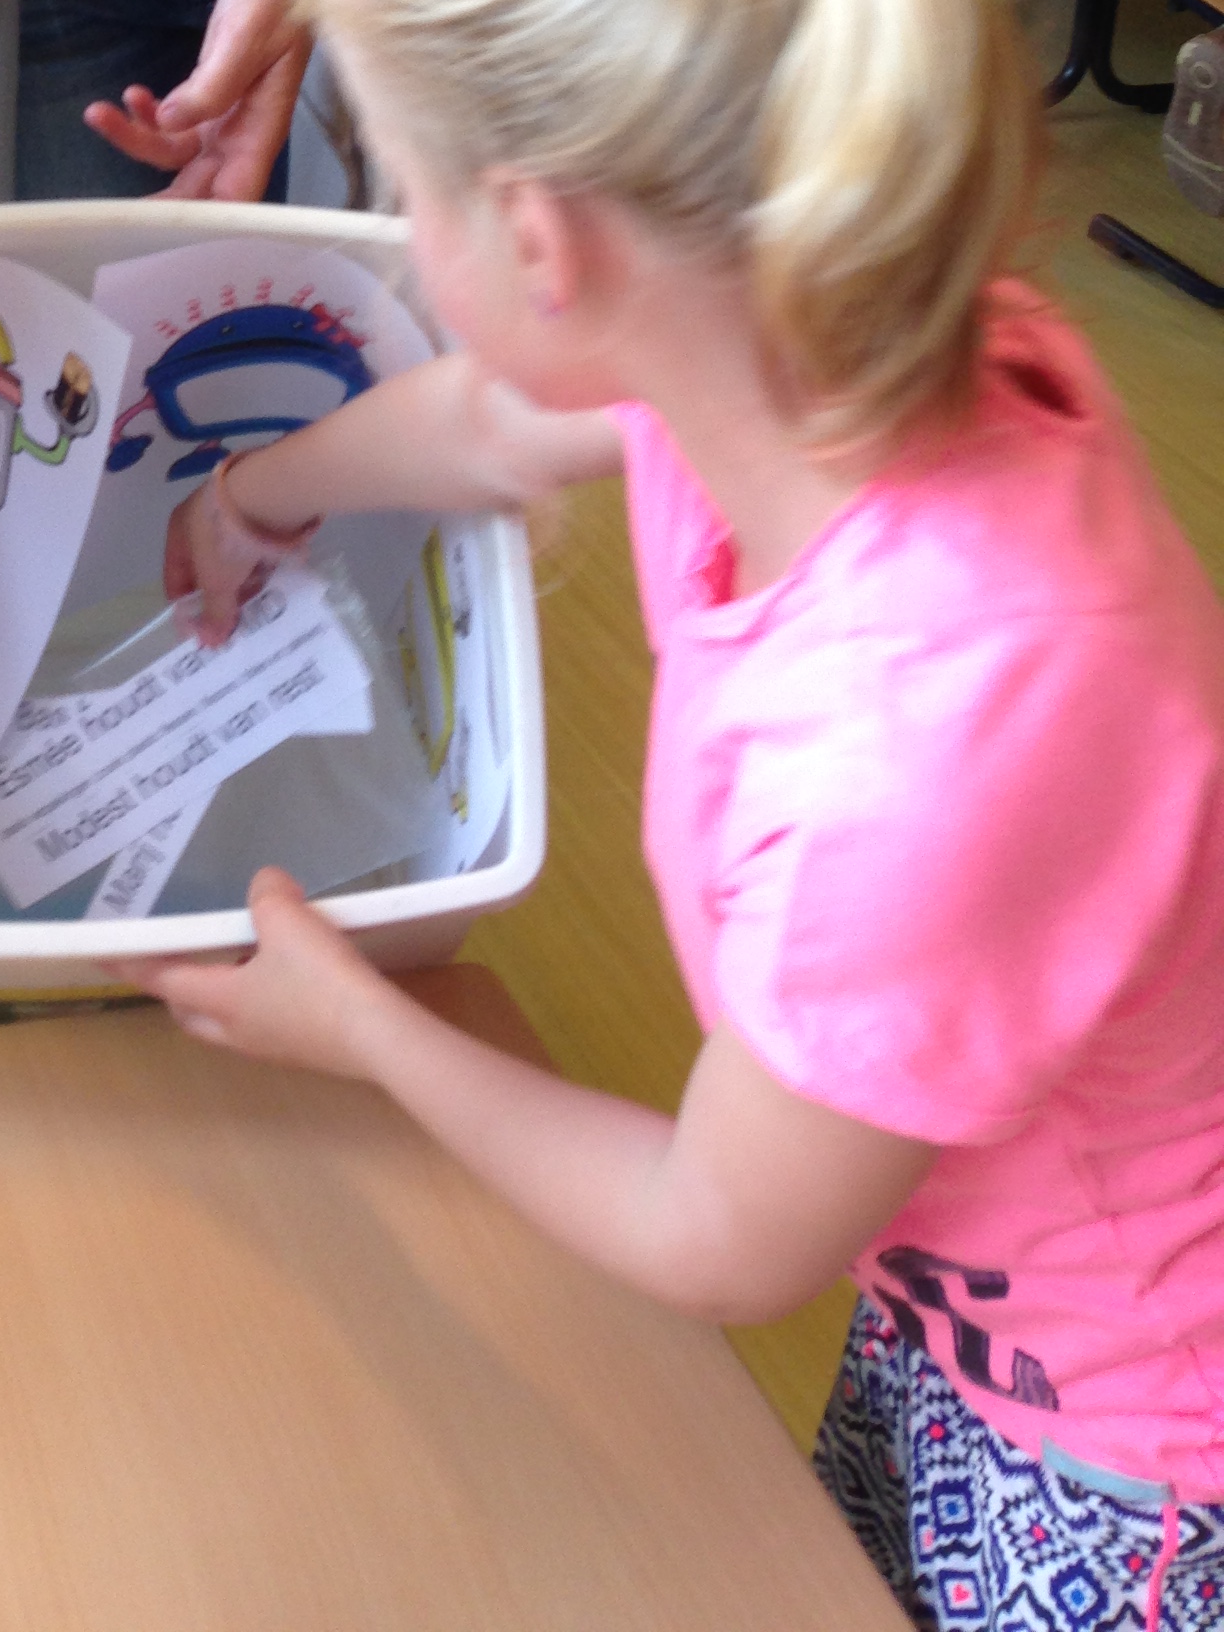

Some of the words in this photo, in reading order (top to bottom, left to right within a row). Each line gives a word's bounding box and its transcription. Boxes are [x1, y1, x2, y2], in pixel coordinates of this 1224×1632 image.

[34, 786, 140, 863] Modest
[129, 732, 220, 801] houdt
[213, 698, 272, 742] van
[267, 655, 328, 711] rest
[78, 673, 169, 742] houdt
